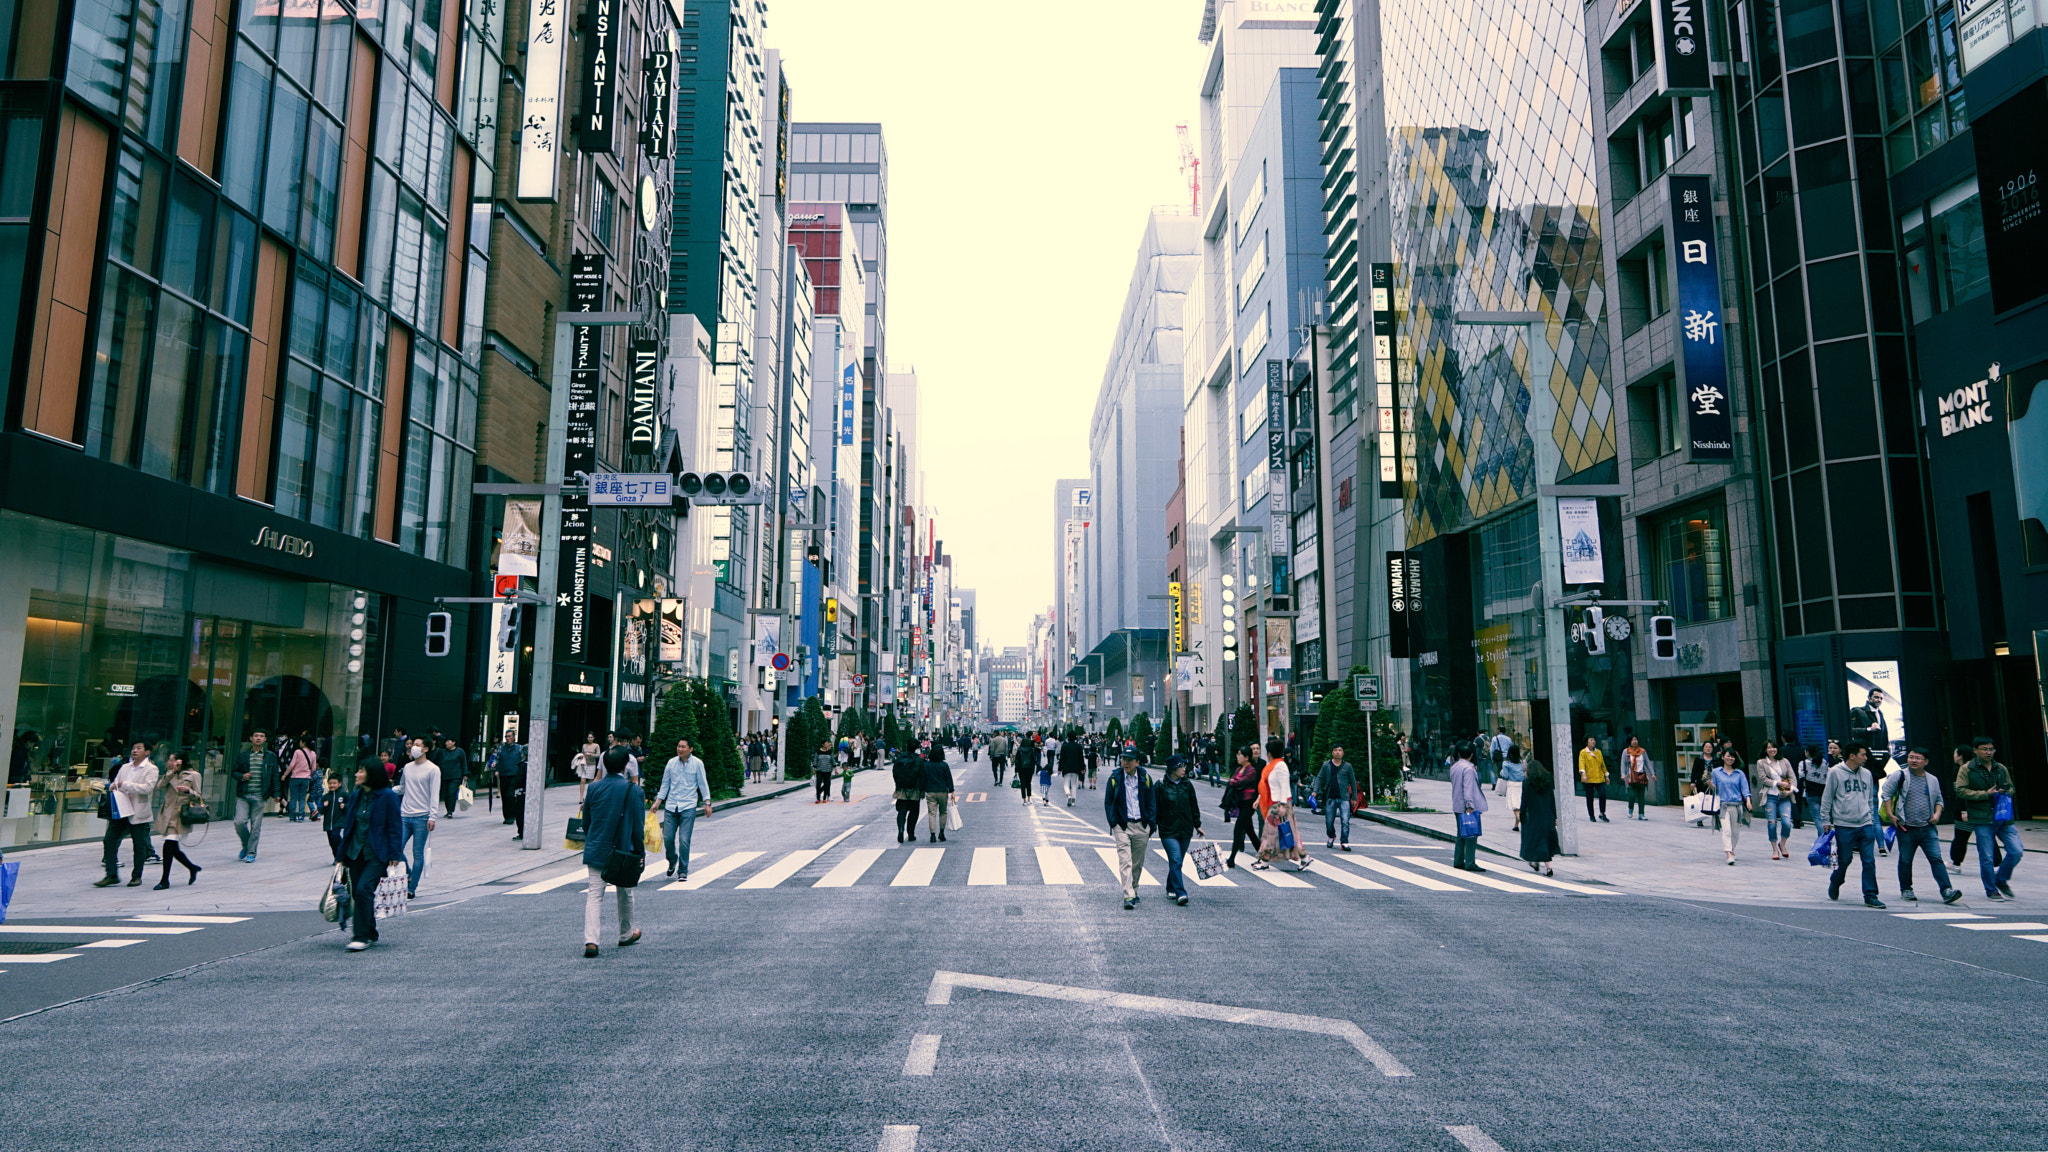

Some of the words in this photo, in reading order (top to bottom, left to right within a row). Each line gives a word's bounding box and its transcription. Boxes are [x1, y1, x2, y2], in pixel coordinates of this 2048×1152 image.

[653, 54, 668, 153] DAMIANI
[1999, 169, 2037, 200] 1906
[1683, 189, 1700, 222] 銀座
[2002, 200, 2040, 225] PIONEERING
[2003, 217, 2023, 232] SINCE
[1682, 239, 1724, 415] 日新堂
[632, 351, 656, 442] DAMIANI
[1938, 379, 1989, 416] MONT
[1941, 401, 1993, 437] BLANC
[1270, 433, 1284, 469] ダンス
[1693, 441, 1731, 449] Nisshindo
[595, 481, 667, 494] 銀座七丁目
[251, 526, 314, 558] SHISEIDO
[574, 547, 586, 603] CONSTANTIN
[1390, 558, 1404, 599] YAMAHA
[571, 605, 583, 655] VACHERON
[1194, 641, 1204, 687] ZARA
[1844, 779, 1867, 792] GAP
